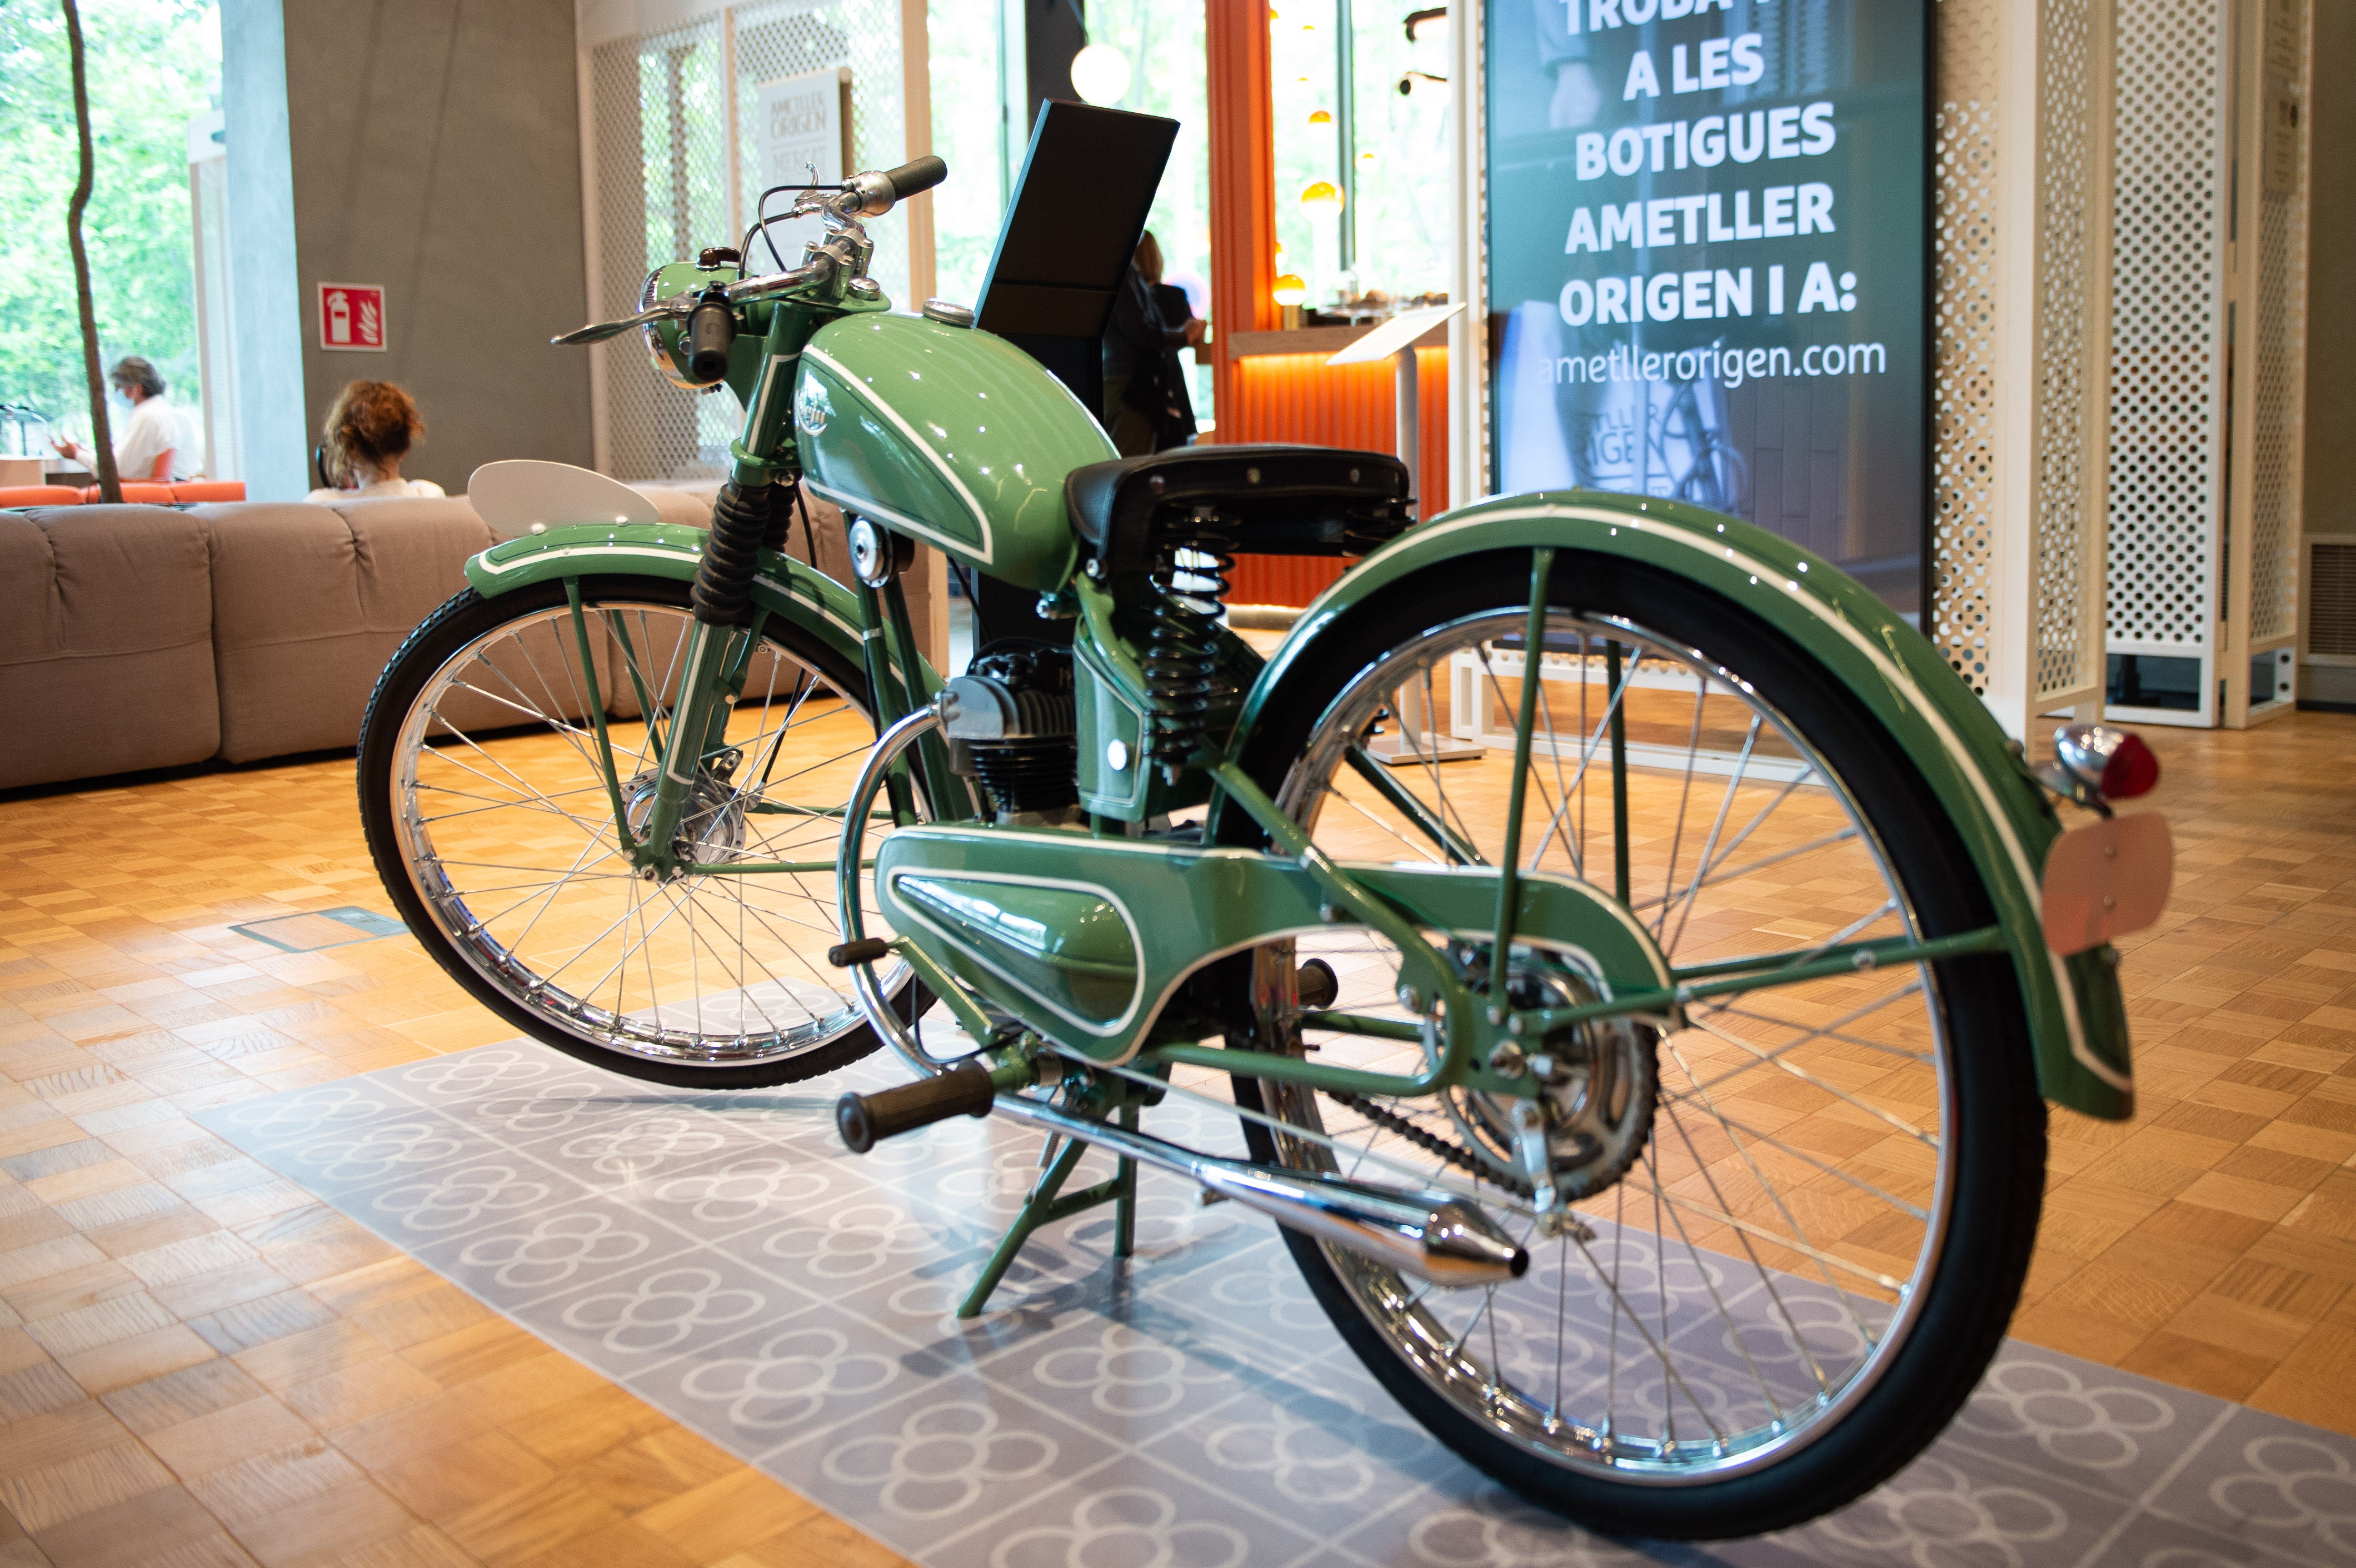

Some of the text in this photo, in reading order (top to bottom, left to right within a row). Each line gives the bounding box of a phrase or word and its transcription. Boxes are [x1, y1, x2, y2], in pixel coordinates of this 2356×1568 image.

[1623, 33, 1765, 101] A LES
[1575, 102, 1837, 181] BOTIGUES
[1564, 182, 1836, 254] AMETLLER
[1558, 261, 1857, 327] ORIGEN I A:
[1538, 342, 1886, 388] ametllerorigen.com
